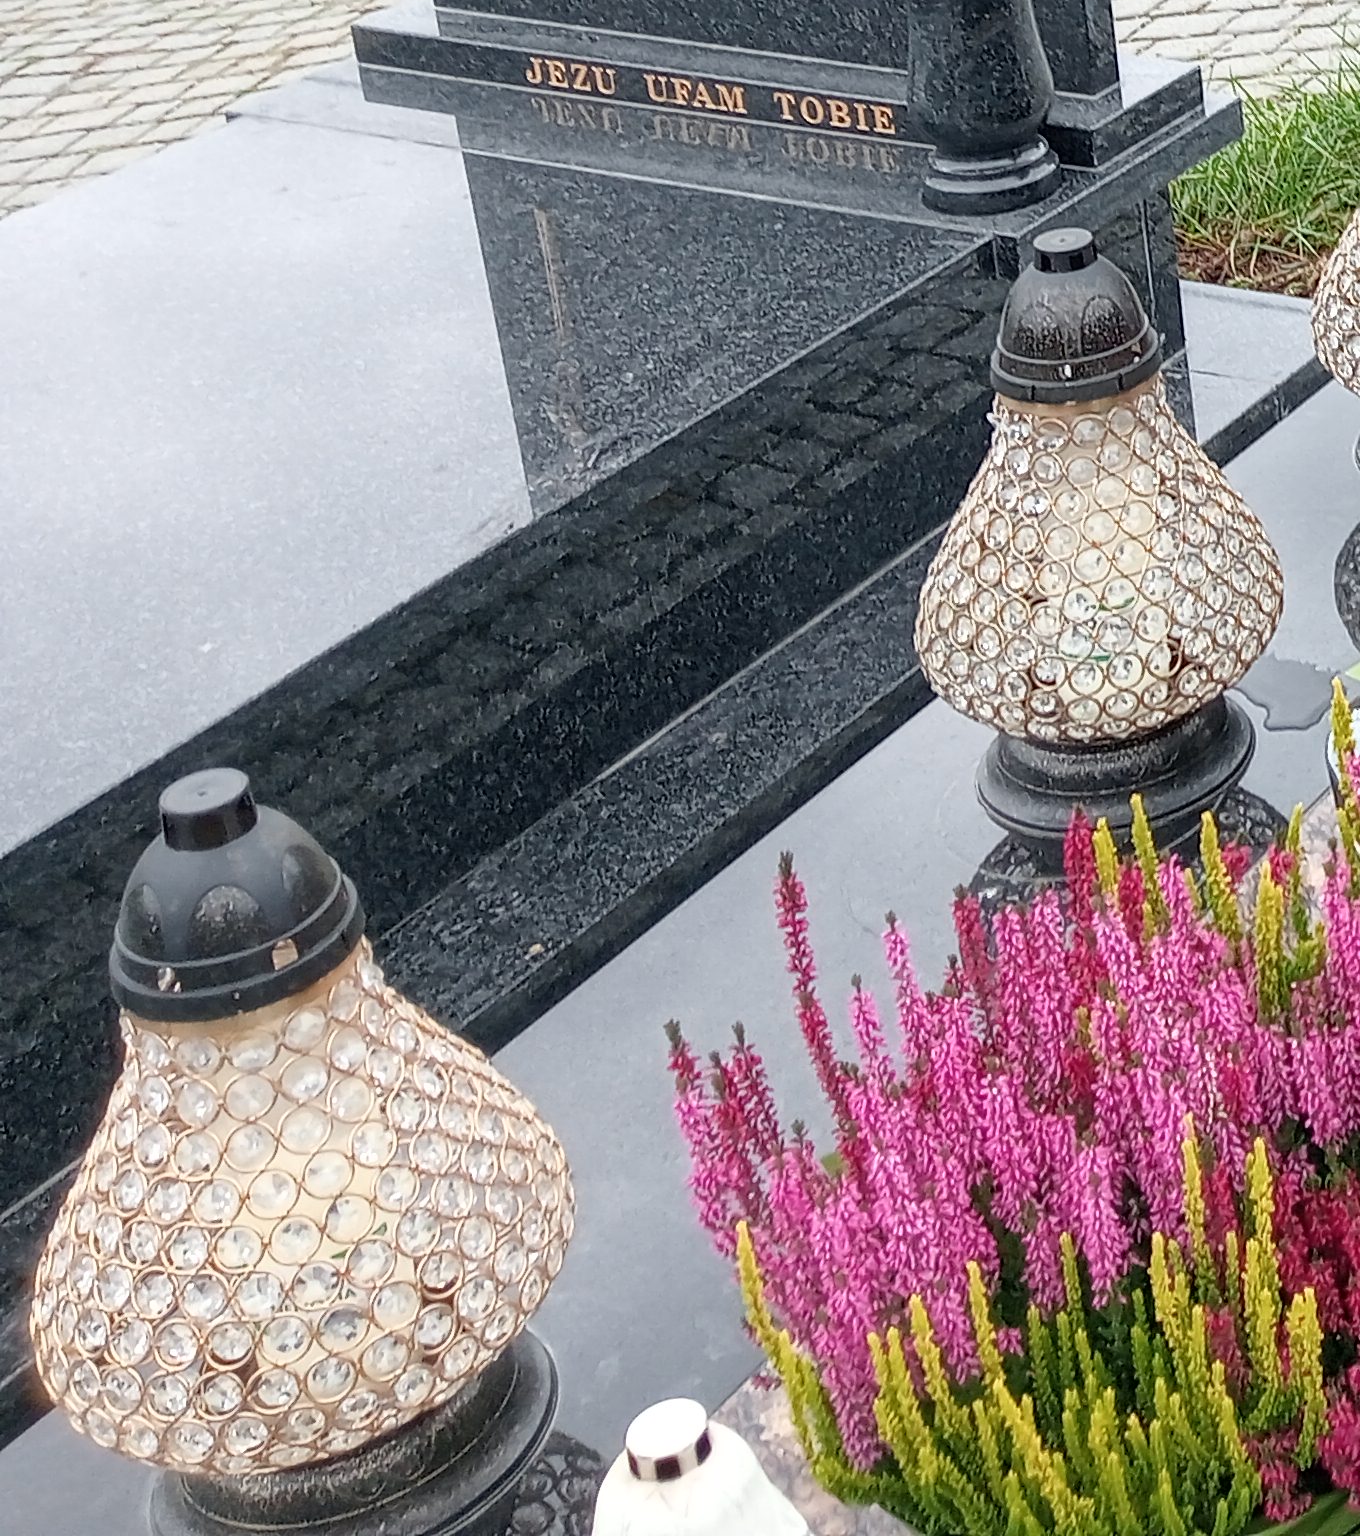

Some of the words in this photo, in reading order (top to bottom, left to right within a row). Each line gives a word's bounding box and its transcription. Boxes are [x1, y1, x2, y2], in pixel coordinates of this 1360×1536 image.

[525, 56, 617, 96] JEZU
[643, 73, 747, 115] UFAM
[773, 91, 896, 135] TOBIE
